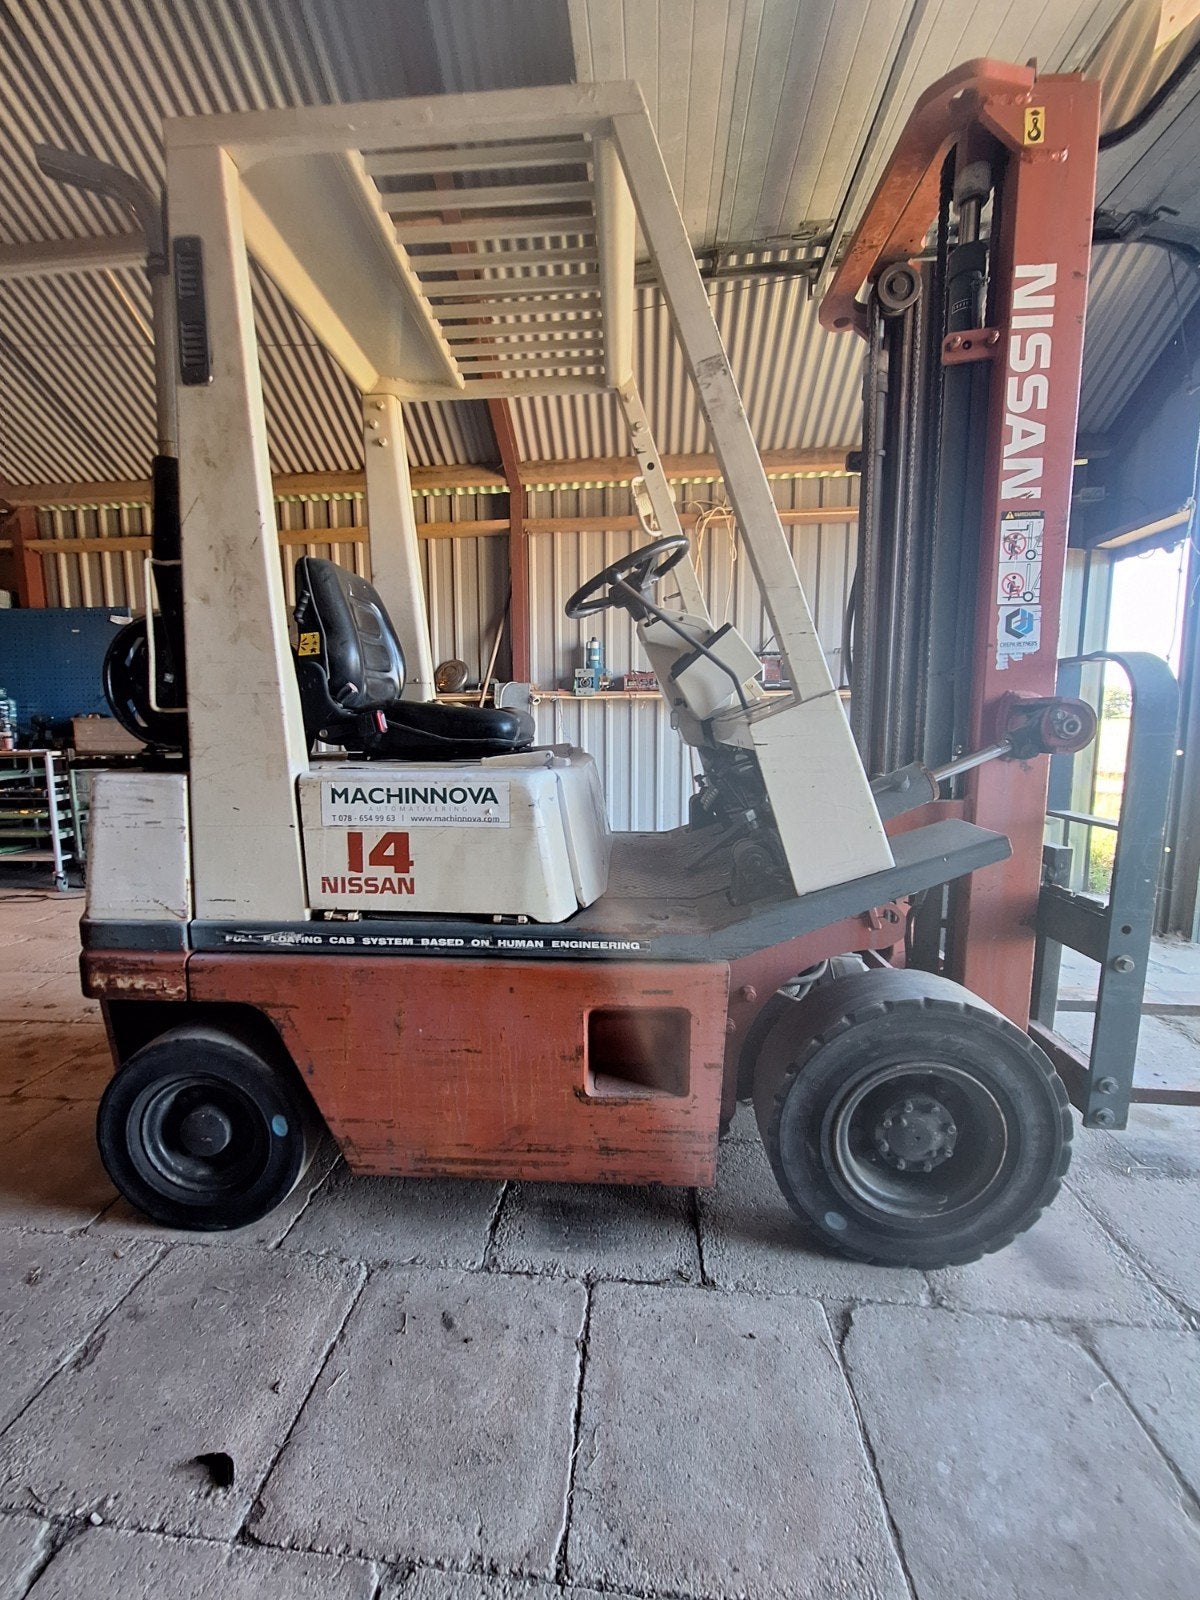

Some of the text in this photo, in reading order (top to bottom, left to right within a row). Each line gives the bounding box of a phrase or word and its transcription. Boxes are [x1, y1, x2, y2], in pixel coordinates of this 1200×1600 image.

[1001, 262, 1058, 500] NISSAN
[331, 787, 499, 805] MACHINNOVA
[410, 815, 501, 824] www.machinnova.com
[347, 831, 415, 874] 14
[321, 876, 415, 895] NISSAN
[263, 934, 323, 945] FLOATING
[329, 936, 356, 945] CAB
[362, 937, 414, 946] SYSTEM
[421, 938, 464, 947] BASED
[471, 938, 490, 947] ON
[497, 939, 544, 948] HUMAN
[552, 940, 640, 950] ENGINEERING
